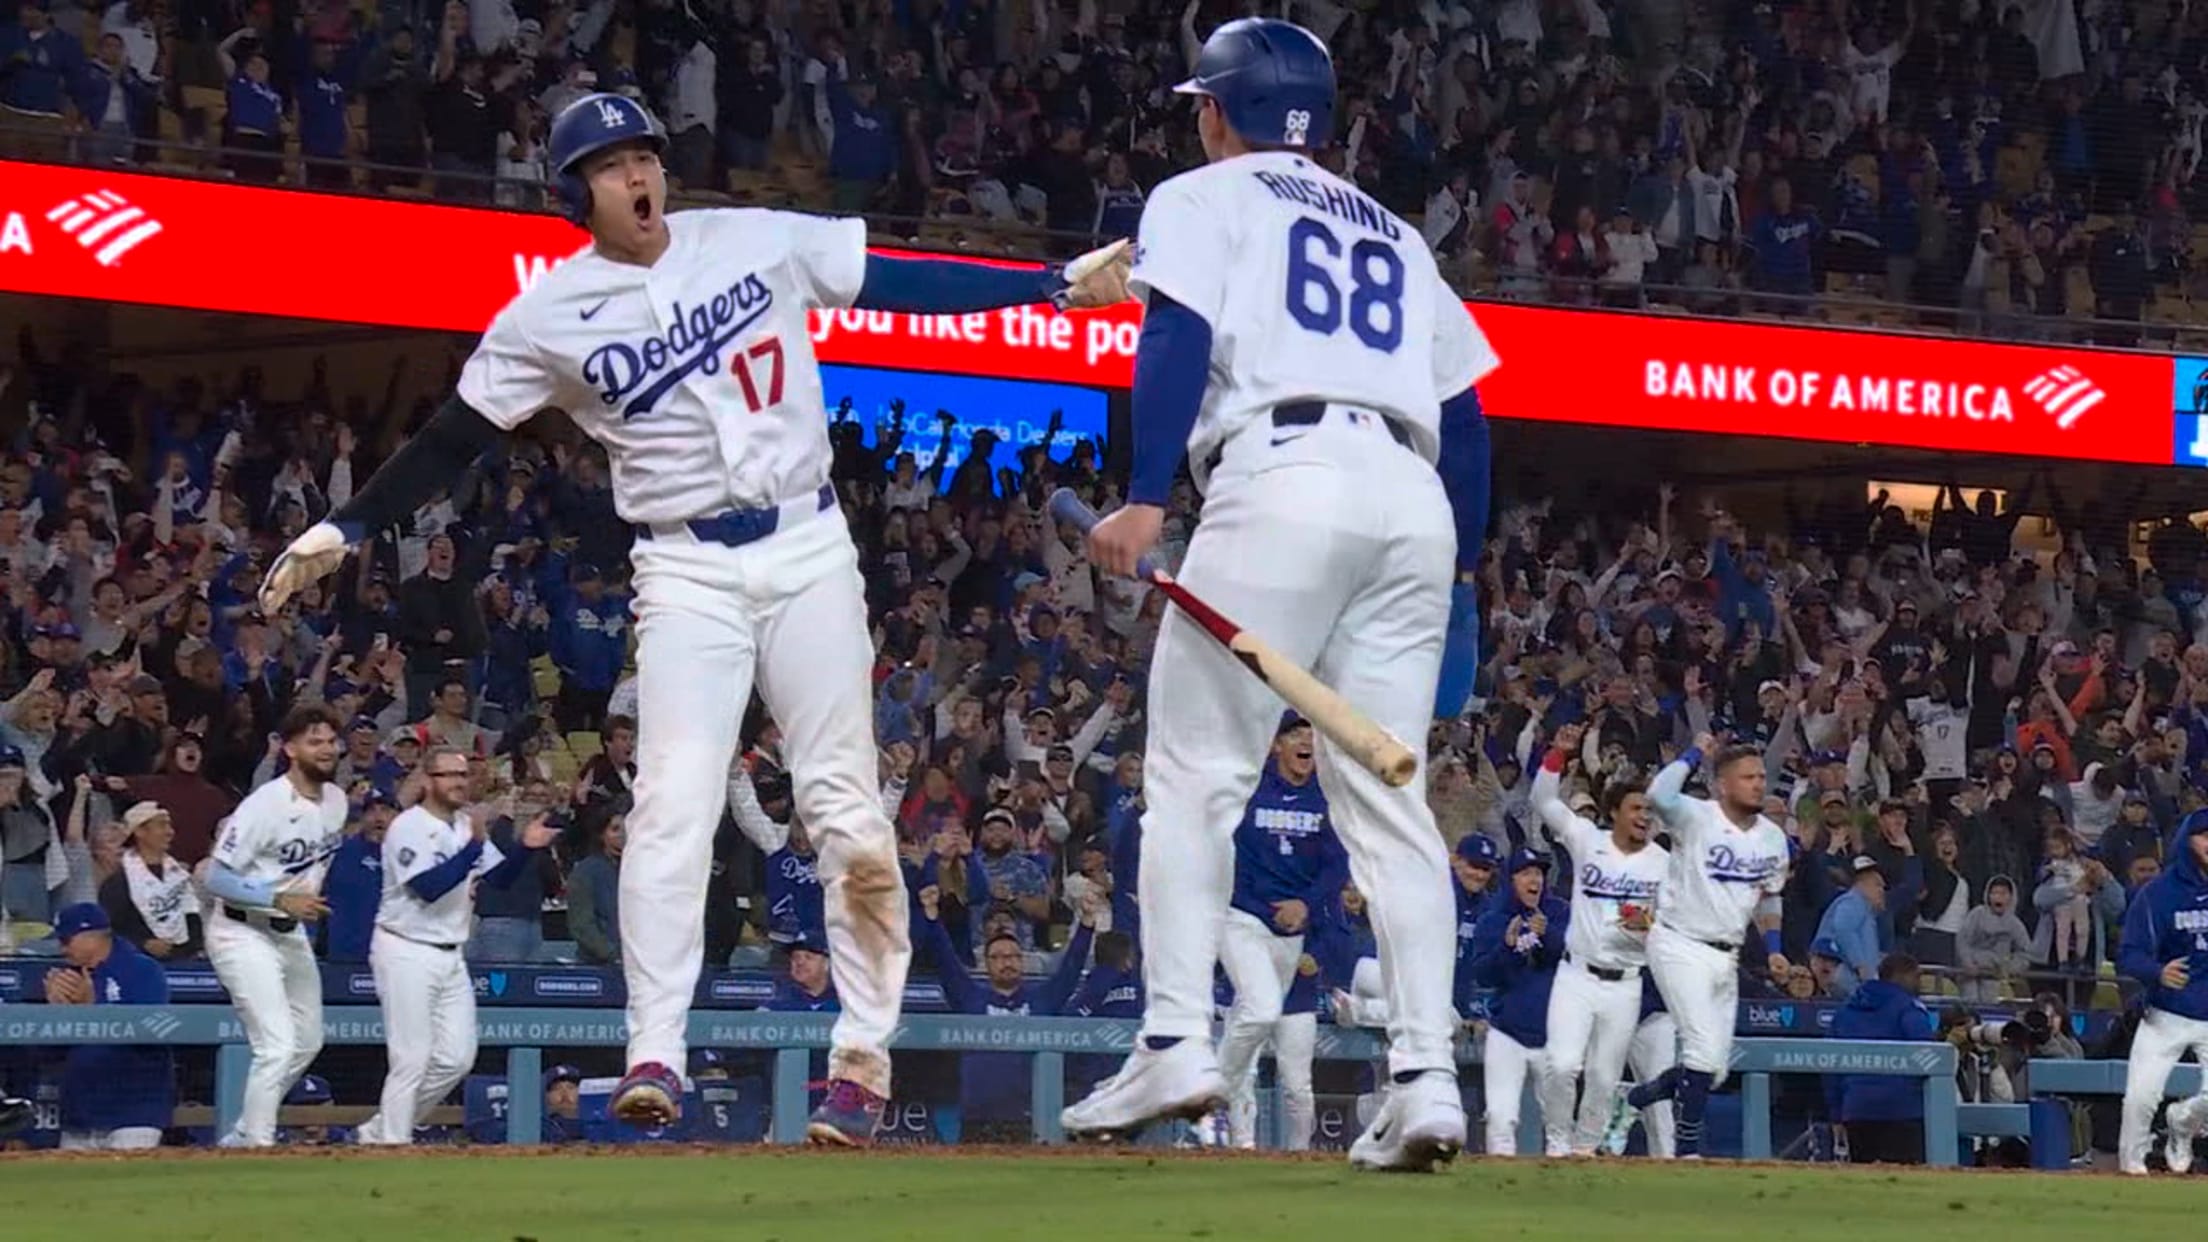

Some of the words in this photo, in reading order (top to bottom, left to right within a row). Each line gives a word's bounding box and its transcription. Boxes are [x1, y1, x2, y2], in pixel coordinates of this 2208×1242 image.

[595, 100, 627, 128] LA
[1286, 109, 1311, 131] 68
[1252, 170, 1400, 241] RUSHING
[1286, 216, 1404, 354] 68
[582, 271, 773, 407] Dodgers
[1001, 304, 1073, 350] the
[731, 336, 785, 414] 17
[1645, 359, 1757, 403] BANK
[1768, 368, 1820, 407] OF
[1829, 373, 2015, 423] AMERICA
[1580, 864, 1660, 896] Dodger
[1749, 1005, 1781, 1023] blue
[8, 1022, 41, 1038] OF
[43, 1021, 136, 1038] AMERICA
[218, 1022, 244, 1038] BA
[323, 1022, 385, 1039] MERIC
[528, 1024, 552, 1040] OF
[554, 1024, 629, 1041] AMERIC
[711, 1025, 761, 1042] BANK
[764, 1026, 787, 1042] OF
[940, 1027, 986, 1045] BANK
[990, 1029, 1012, 1045] OF
[1014, 1030, 1093, 1047] AMERICA
[1773, 1052, 1815, 1068] BANK
[1818, 1053, 1837, 1068] OF
[1839, 1054, 1908, 1070] AMERICA
[714, 1105, 729, 1128] 5
[880, 1100, 927, 1132] ue
